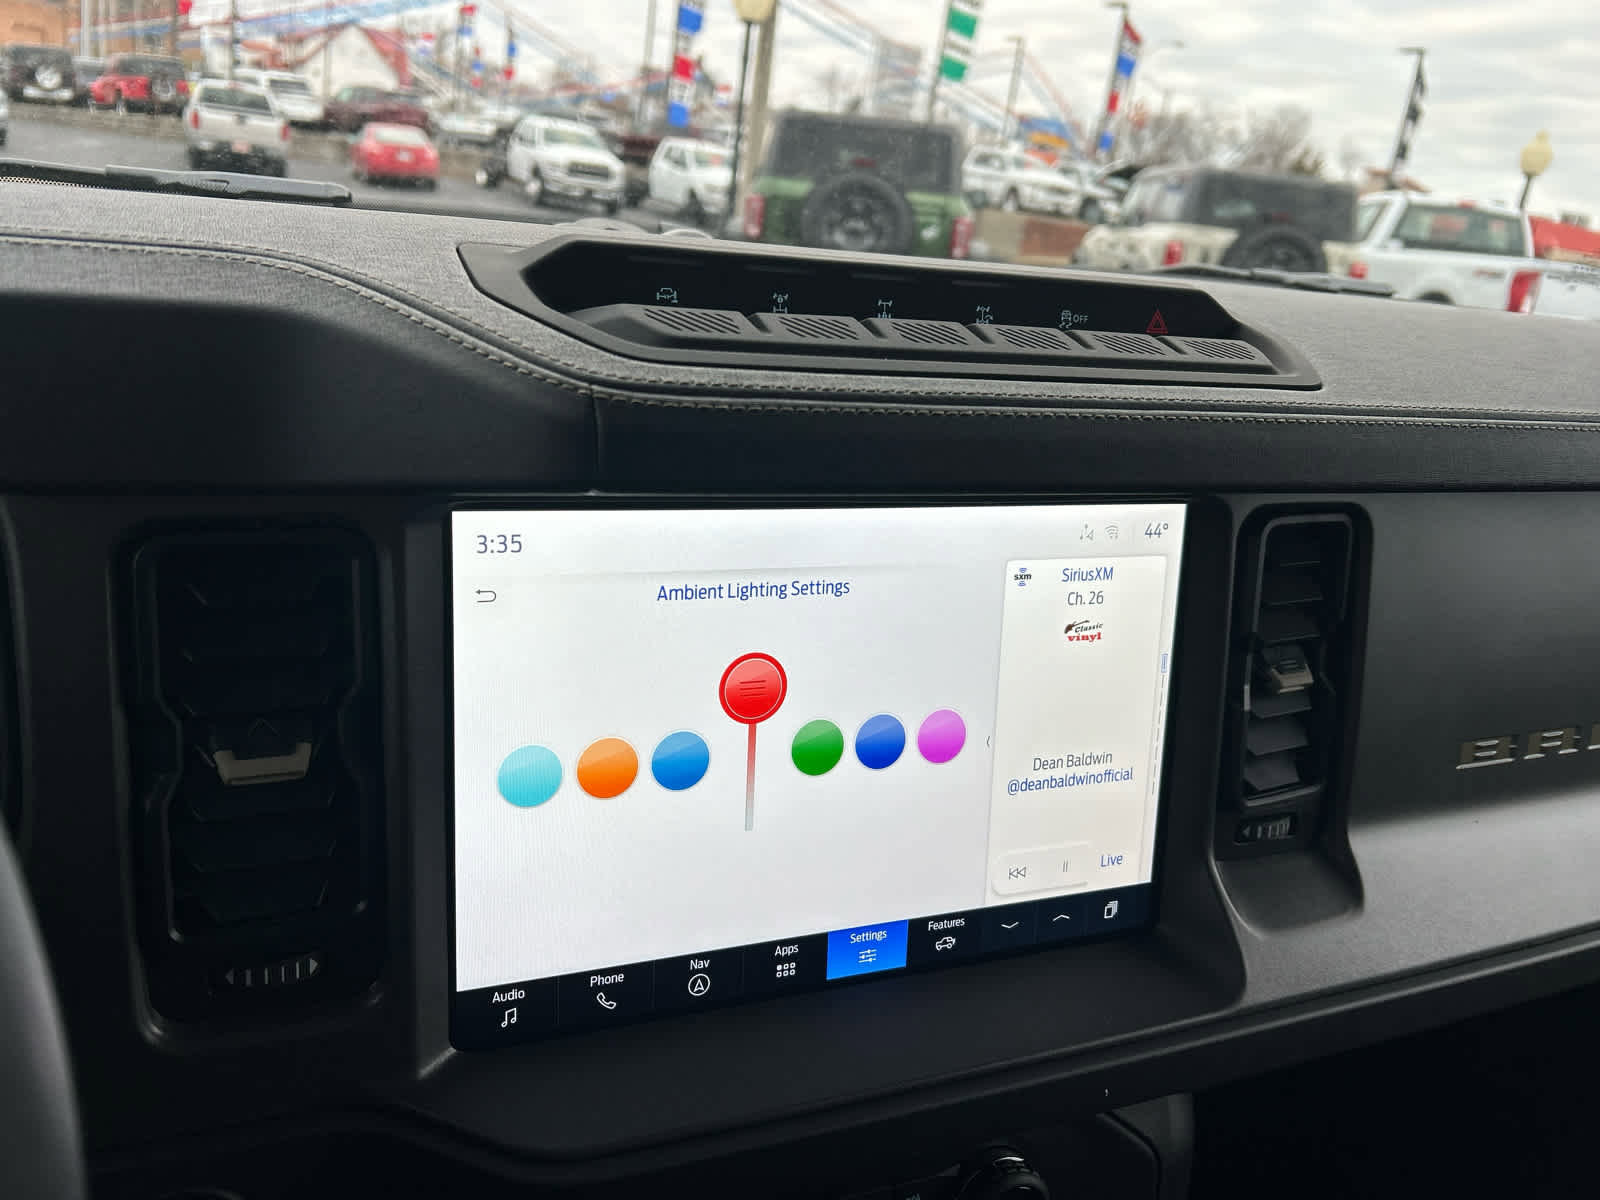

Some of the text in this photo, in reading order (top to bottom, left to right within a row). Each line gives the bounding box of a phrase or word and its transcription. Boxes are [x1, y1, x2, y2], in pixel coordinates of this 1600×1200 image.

[1072, 314, 1089, 324] OFF
[1144, 523, 1169, 539] 44°
[476, 534, 522, 554] 3:35
[1013, 573, 1032, 581] sxm
[1061, 566, 1114, 582] SiriusXM
[657, 579, 850, 601] Ambient Lighting Settings
[1067, 591, 1104, 606] Ch. 26
[1074, 622, 1104, 633] Classic
[1067, 632, 1102, 642] vinyl
[1032, 752, 1113, 772] Dean Baldwin
[1007, 767, 1134, 796] @deanbaldwinofficial
[1100, 854, 1123, 868] Live
[927, 917, 966, 932] Features
[849, 928, 888, 944] Settings
[774, 943, 800, 957] Apps
[689, 958, 711, 970] Nav
[589, 971, 625, 988] Phone
[492, 988, 526, 1004] Audio
